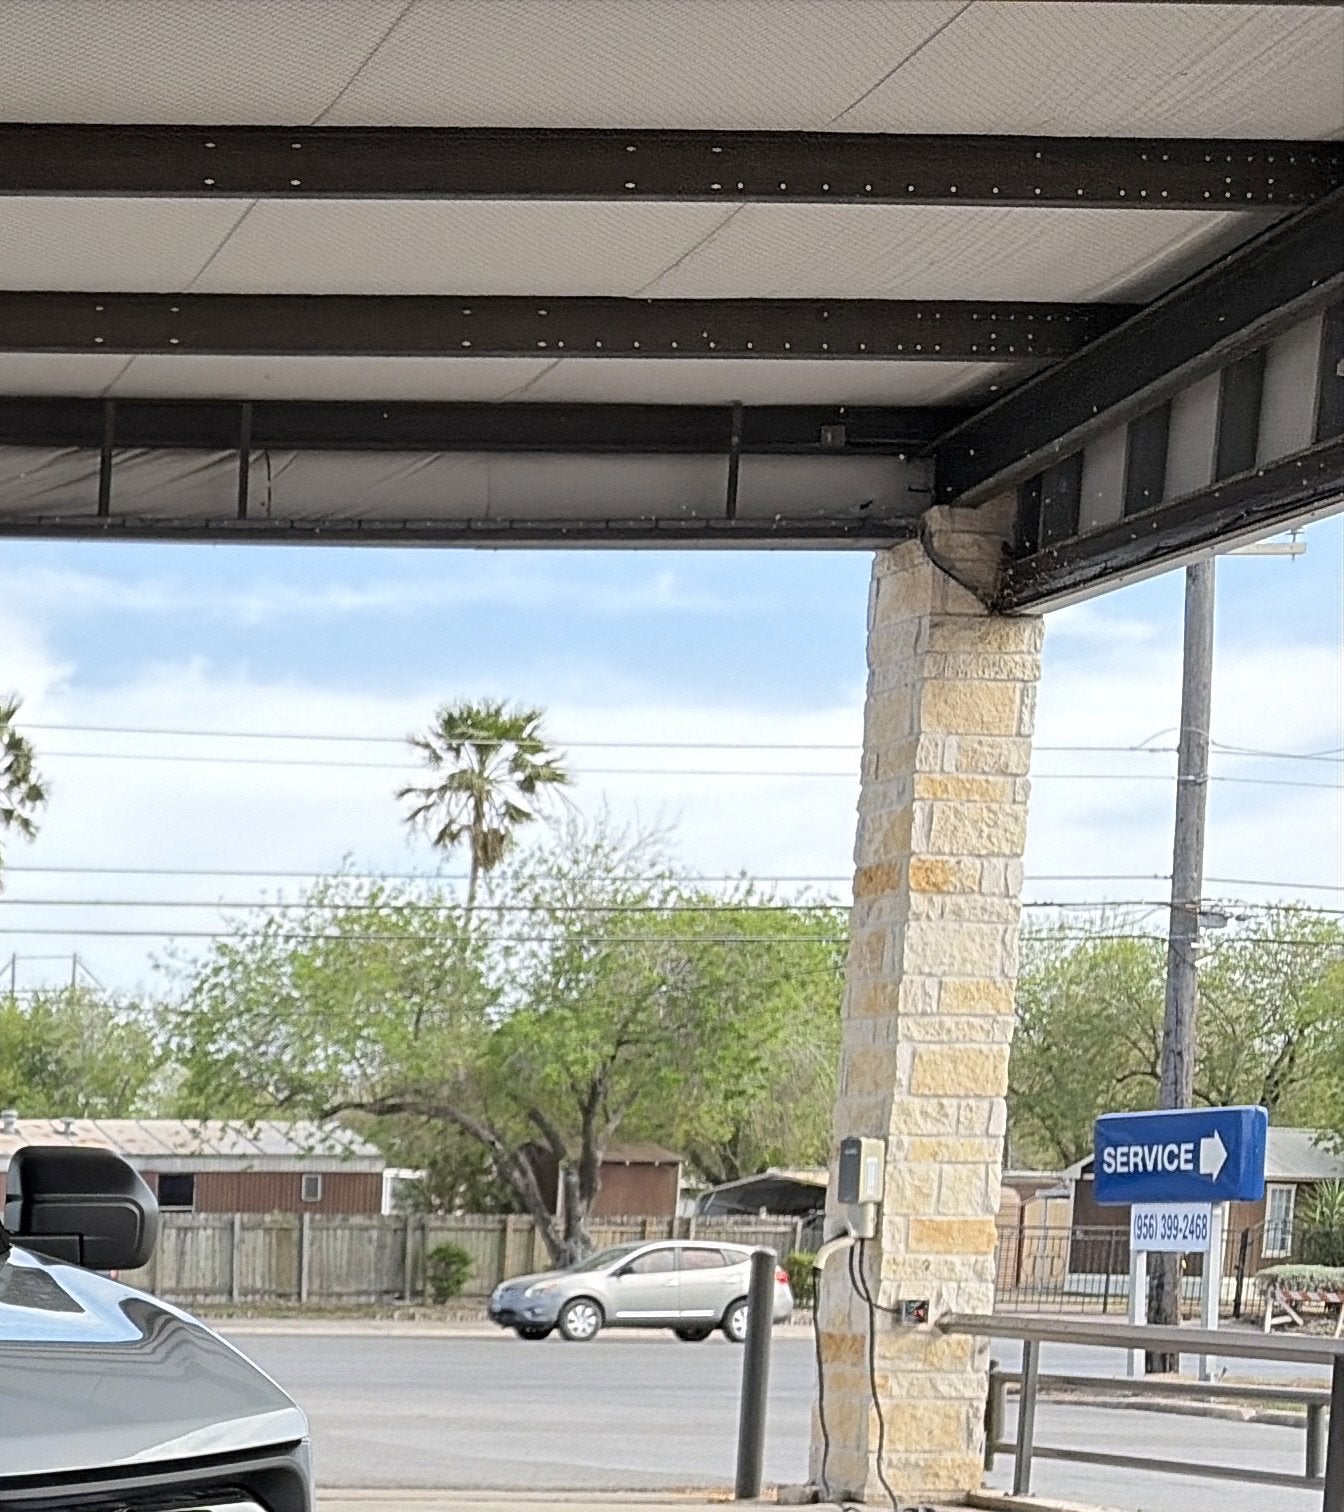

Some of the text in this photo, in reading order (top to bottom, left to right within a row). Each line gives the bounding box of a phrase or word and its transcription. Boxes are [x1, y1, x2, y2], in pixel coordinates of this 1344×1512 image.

[1102, 1142, 1195, 1174] SERVICE
[1133, 1213, 1208, 1240] (956) 399-2468
